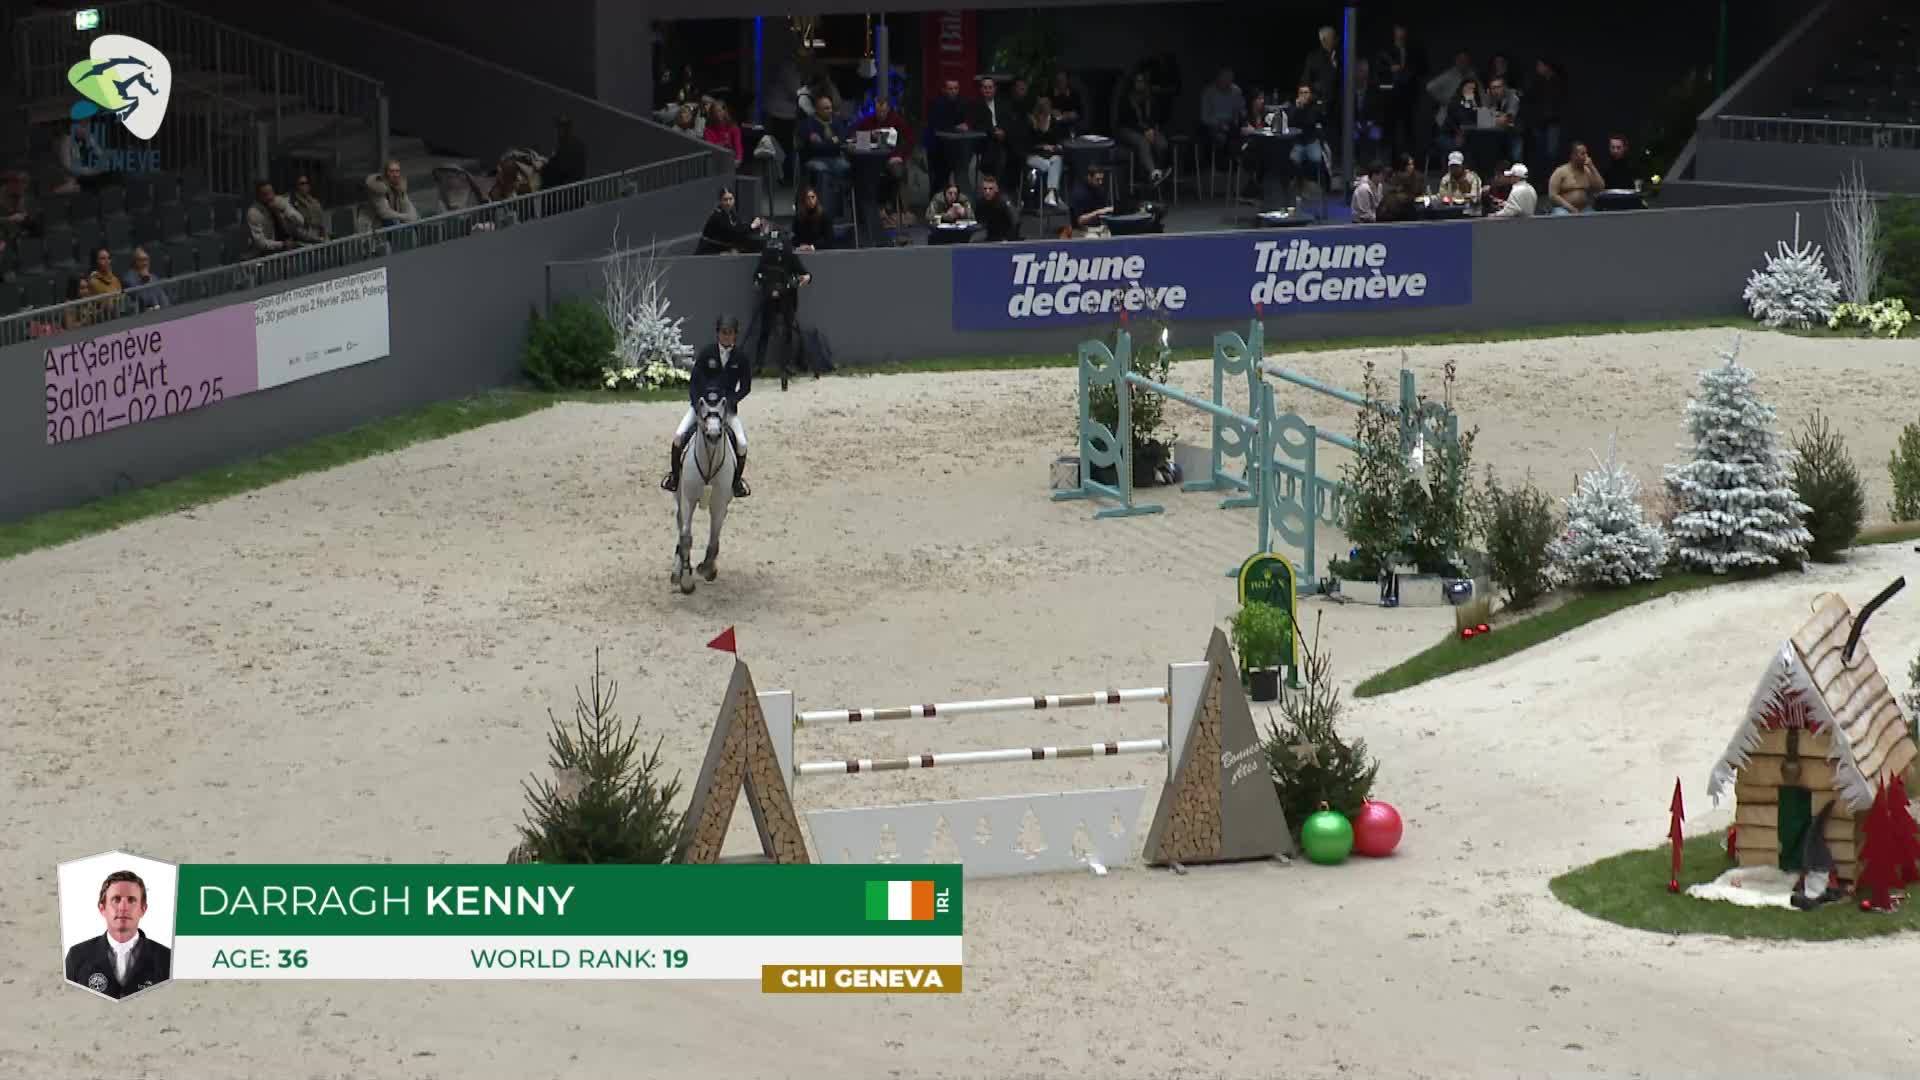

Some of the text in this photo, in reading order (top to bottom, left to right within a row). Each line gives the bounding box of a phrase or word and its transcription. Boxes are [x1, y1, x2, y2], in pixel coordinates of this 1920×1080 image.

[1012, 251, 1145, 285] Tribune
[1255, 239, 1387, 273] Tribune
[1008, 280, 1187, 318] deGenève
[1250, 268, 1427, 305] deGenève
[46, 359, 168, 415] Salon d'Art
[1251, 579, 1286, 591] ROLX
